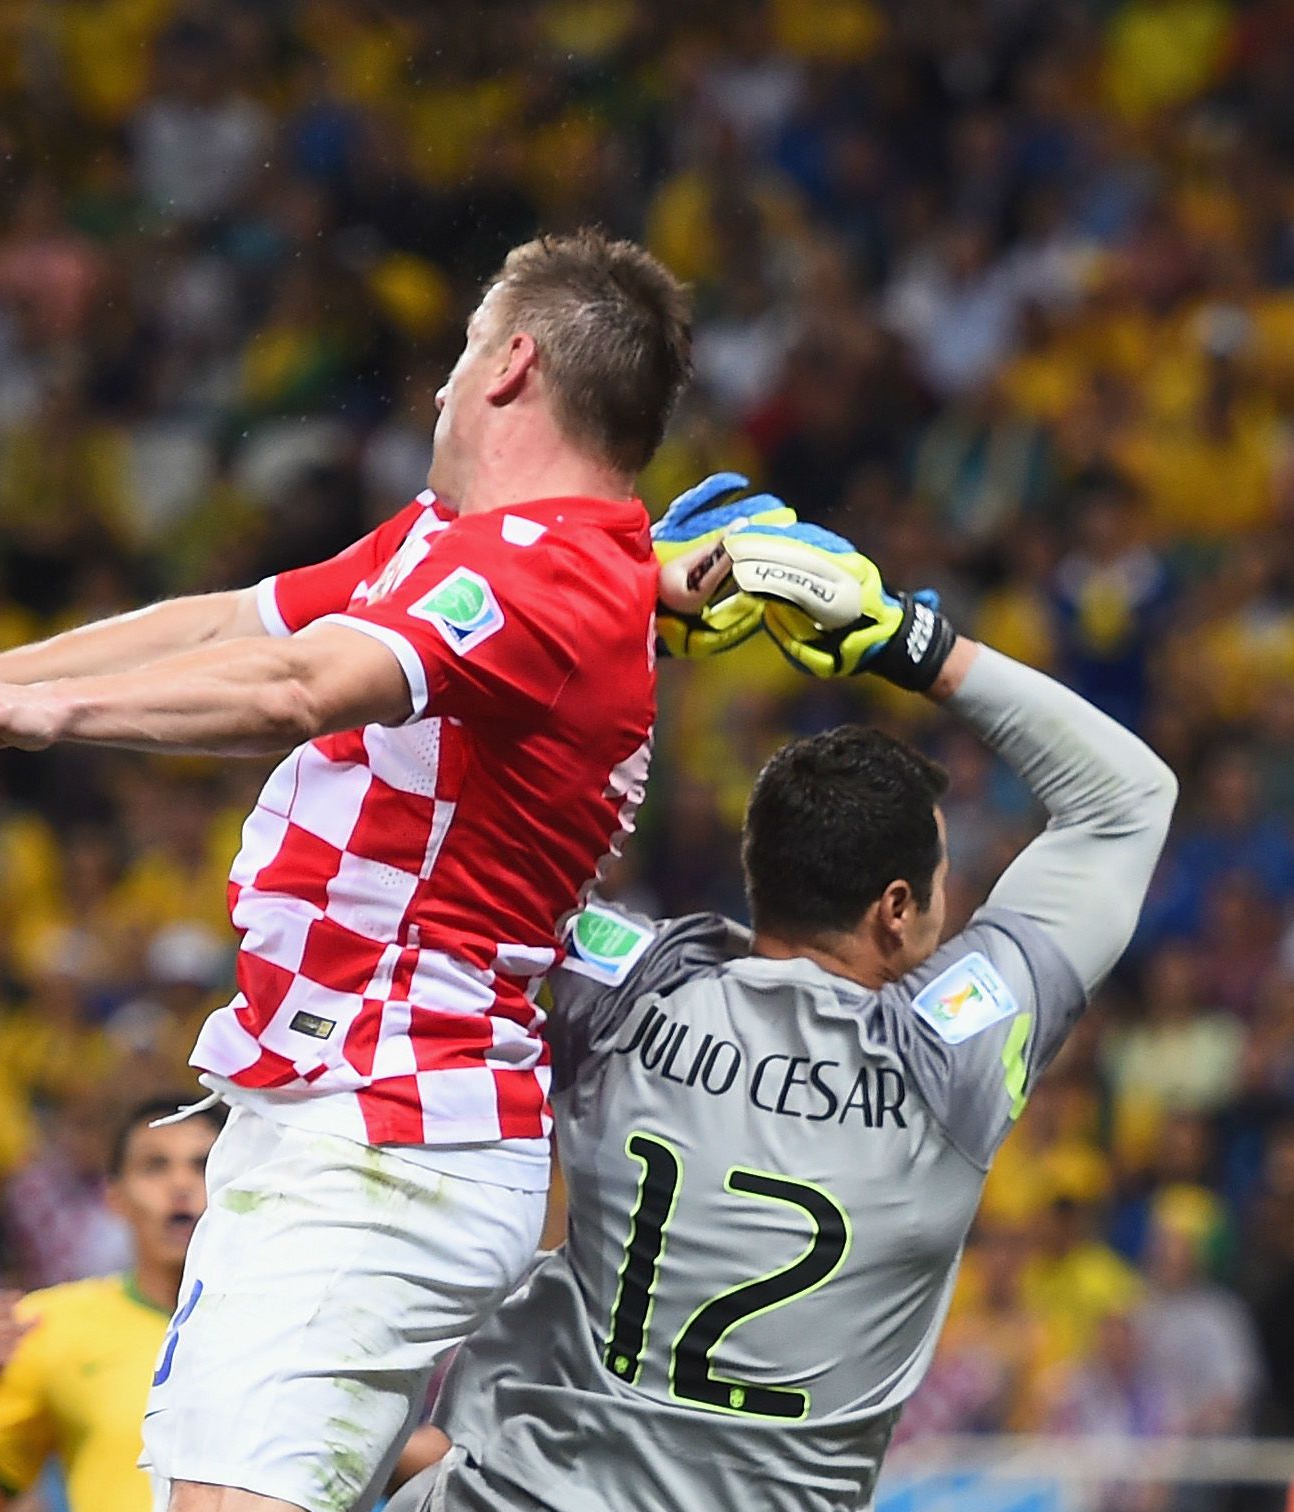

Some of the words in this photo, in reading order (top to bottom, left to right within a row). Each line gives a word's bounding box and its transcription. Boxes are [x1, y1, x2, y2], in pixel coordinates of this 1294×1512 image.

[755, 564, 836, 603] reusch
[615, 1005, 742, 1097] JULIO
[749, 1053, 909, 1130] CESAR
[600, 1130, 853, 1421] 12
